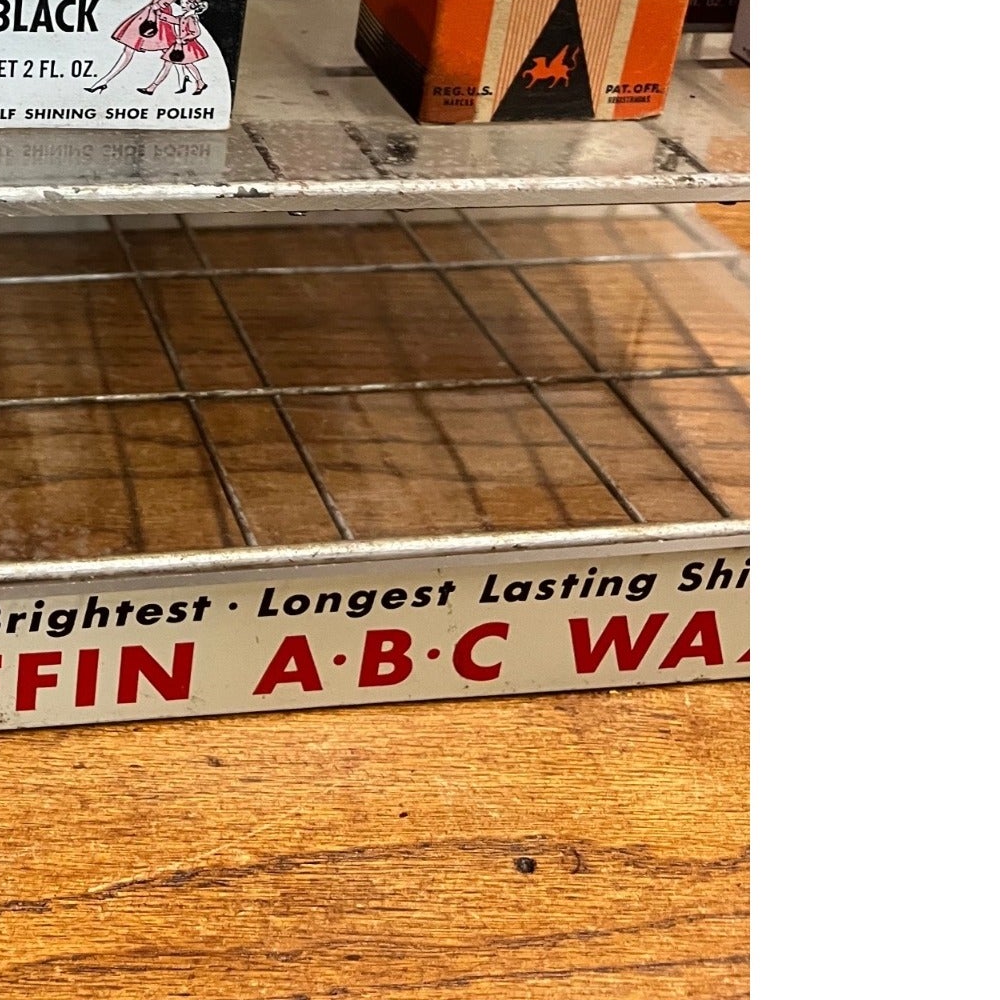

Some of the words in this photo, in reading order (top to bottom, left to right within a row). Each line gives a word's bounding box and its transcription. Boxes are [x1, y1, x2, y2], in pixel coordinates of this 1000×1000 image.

[22, 60, 34, 78] 2
[38, 60, 65, 79] FL.
[71, 60, 98, 79] OZ.
[433, 86, 464, 96] REG.
[605, 84, 631, 94] PAT.
[24, 108, 97, 120] SHINING
[105, 108, 149, 120] SHOE
[156, 107, 215, 120] POLISH
[256, 580, 456, 619] Longest
[478, 566, 658, 602] Lasting
[568, 610, 750, 675] WA
